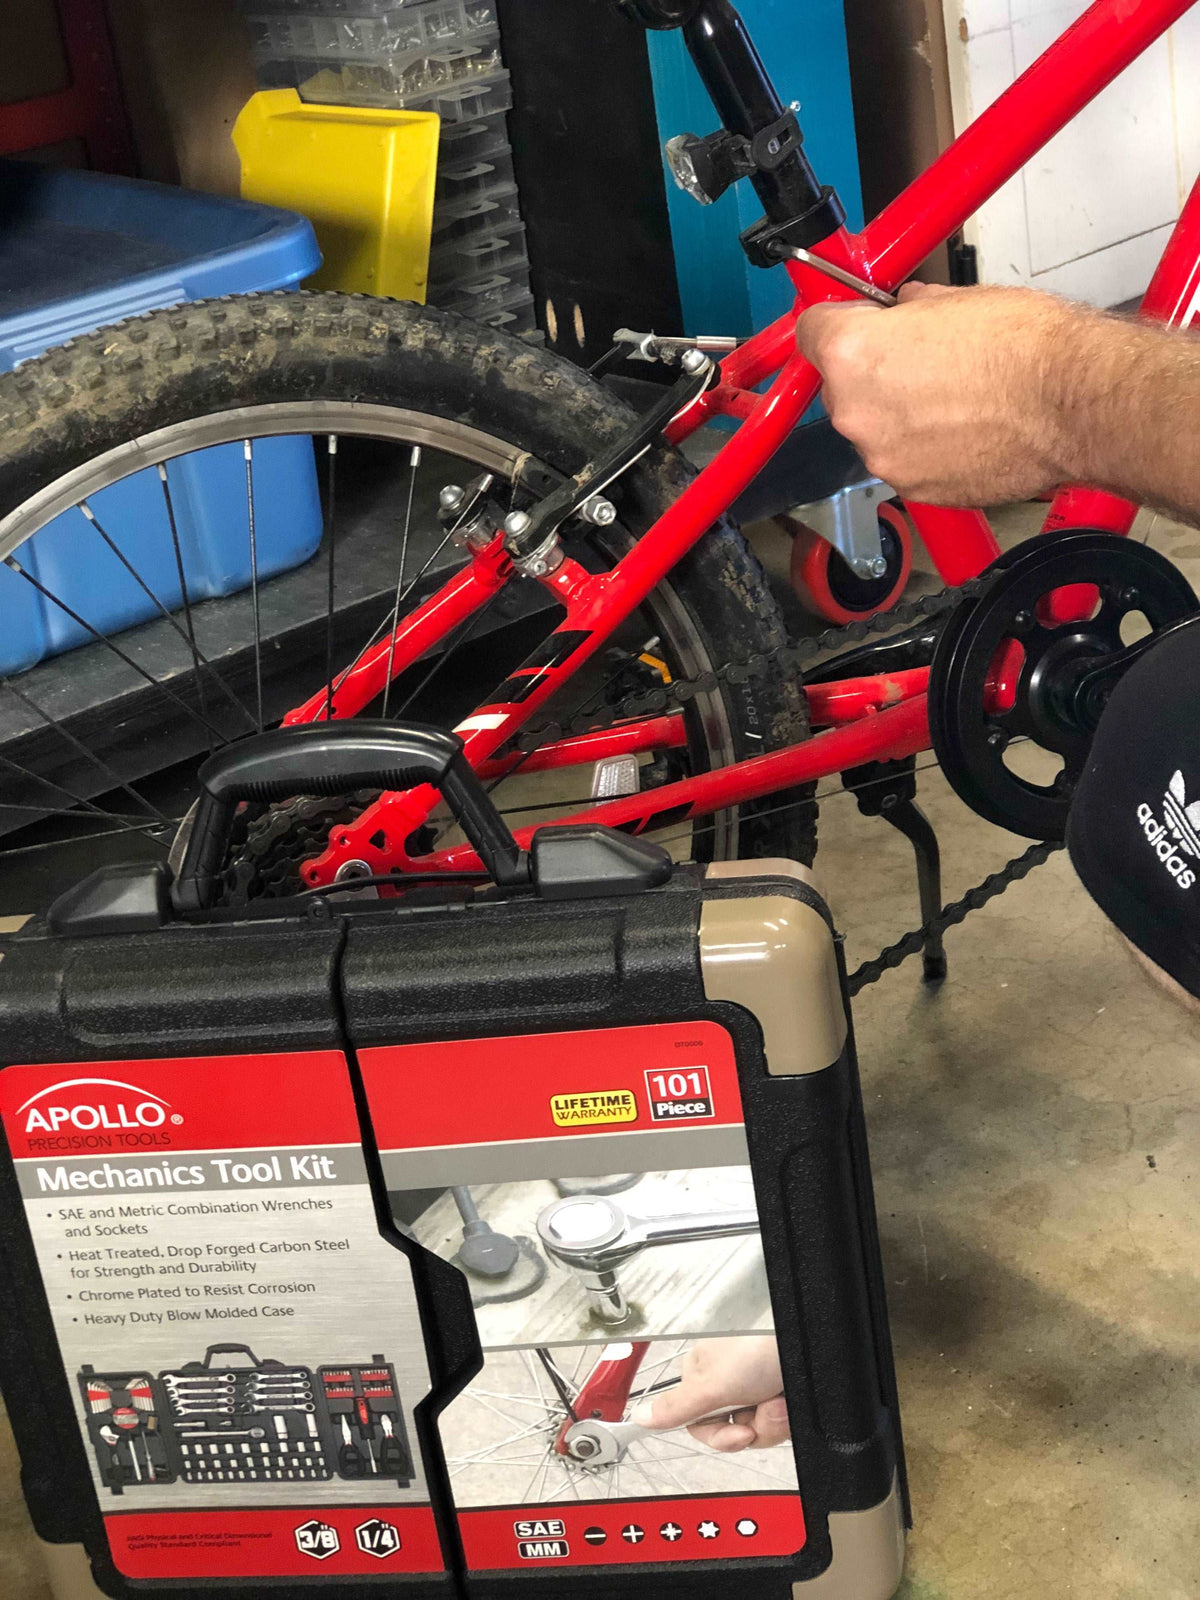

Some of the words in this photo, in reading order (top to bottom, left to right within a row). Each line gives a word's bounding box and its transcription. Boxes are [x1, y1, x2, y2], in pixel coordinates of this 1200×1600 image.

[1137, 803, 1196, 889] adidas
[652, 1072, 701, 1097] 101
[554, 1095, 631, 1110] LIFETIME
[657, 1101, 706, 1116] Piece
[556, 1106, 632, 1120] WARRANTY
[28, 1134, 112, 1151] PRECISION
[116, 1132, 171, 1146] TOOLS
[37, 1161, 205, 1192] Mechanics
[211, 1156, 282, 1184] Tool
[289, 1154, 337, 1180] Kit
[59, 1208, 86, 1221] SAE
[89, 1206, 116, 1219] and
[119, 1204, 164, 1218] Metric
[168, 1200, 259, 1216] Combination
[262, 1198, 333, 1212] Wrenches
[65, 1224, 91, 1238] and
[94, 1222, 148, 1236] Sockets
[69, 1249, 101, 1262] Heat
[168, 1244, 202, 1259] Drop
[206, 1242, 256, 1258] Forged
[259, 1240, 310, 1253] Carbon
[314, 1238, 349, 1251] Steel
[71, 1266, 91, 1279] for
[94, 1263, 154, 1280] Strength
[159, 1262, 185, 1275] and
[188, 1260, 257, 1275] Durability
[79, 1289, 134, 1302] Chrome
[138, 1286, 181, 1299] Plated
[185, 1286, 200, 1298] to
[204, 1284, 243, 1297] Resist
[248, 1281, 316, 1294] Corrosion
[84, 1312, 126, 1326] Heavy
[129, 1311, 164, 1325] Duty
[168, 1309, 201, 1321] Blow
[204, 1306, 258, 1319] Molded
[262, 1305, 294, 1318] Case
[517, 1522, 562, 1536] SAE
[525, 1542, 561, 1556] MM
